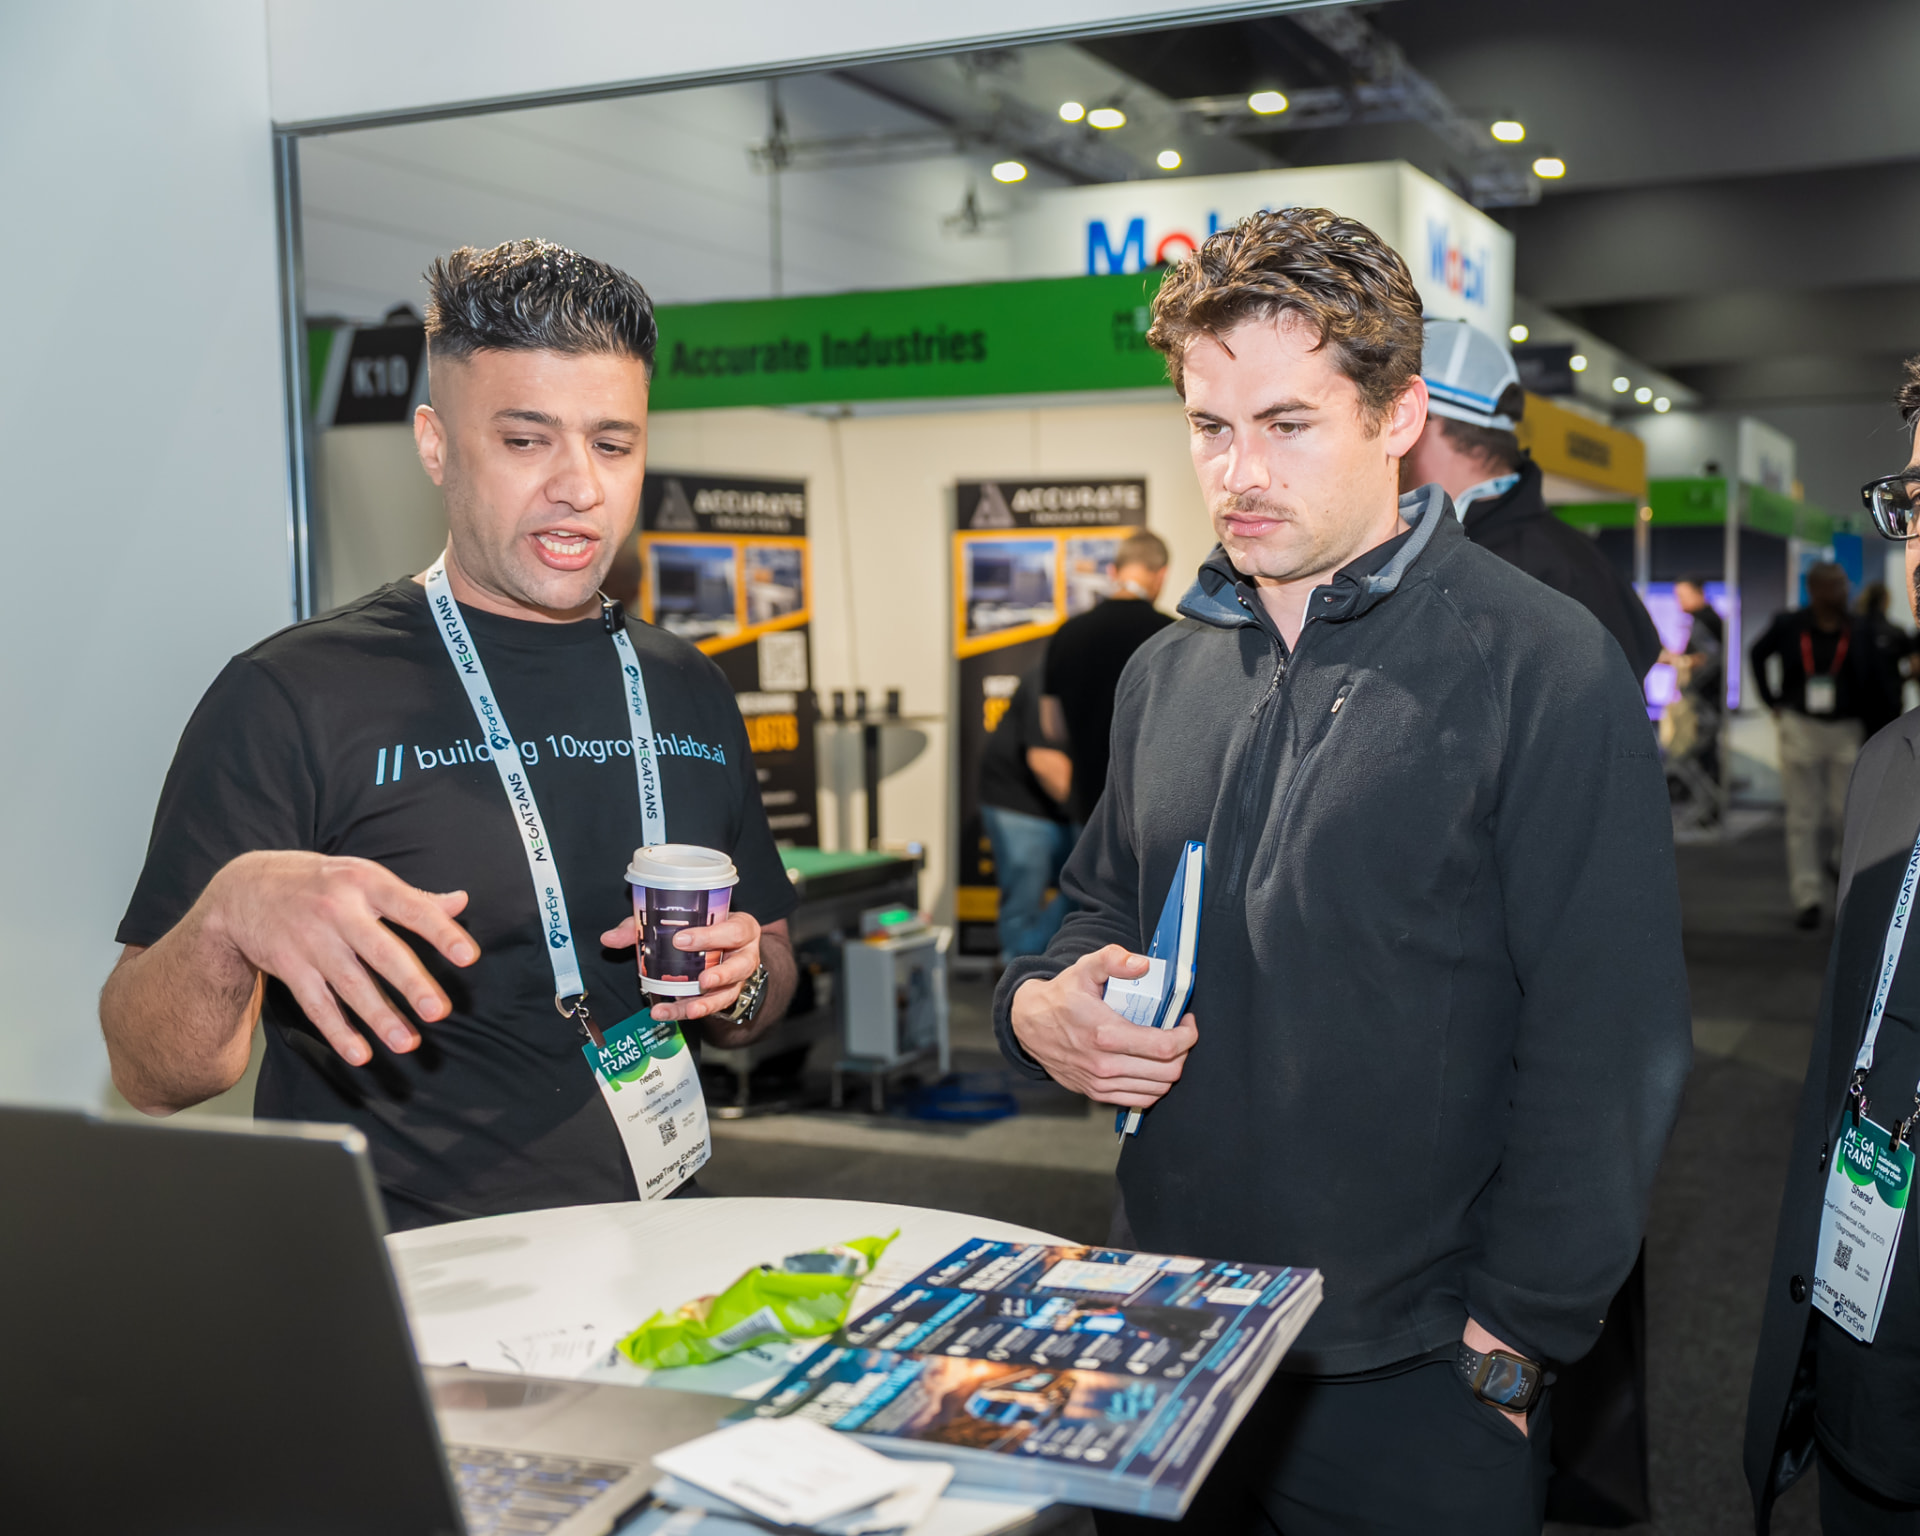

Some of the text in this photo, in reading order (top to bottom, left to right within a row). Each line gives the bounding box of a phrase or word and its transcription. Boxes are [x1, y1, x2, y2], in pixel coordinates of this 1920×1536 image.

[670, 324, 987, 378] Accurate Industries
[352, 355, 409, 397] K10
[1011, 484, 1142, 513] ACCURATE
[436, 595, 478, 674] MEGATRANS
[413, 739, 539, 769] buildg
[545, 733, 727, 765] 10xgrohlabs.ai
[637, 736, 658, 820] MEGATRANS
[508, 773, 548, 862] MEGATRANS
[598, 1034, 637, 1064] MEGA
[602, 1046, 641, 1076] TRANS
[1842, 1140, 1873, 1170] TRANS
[1845, 1127, 1875, 1157] MEGA
[1851, 1184, 1874, 1205] Sharad
[1814, 1277, 1839, 1300] gaTrans
[1839, 1293, 1868, 1321] Exhibitor
